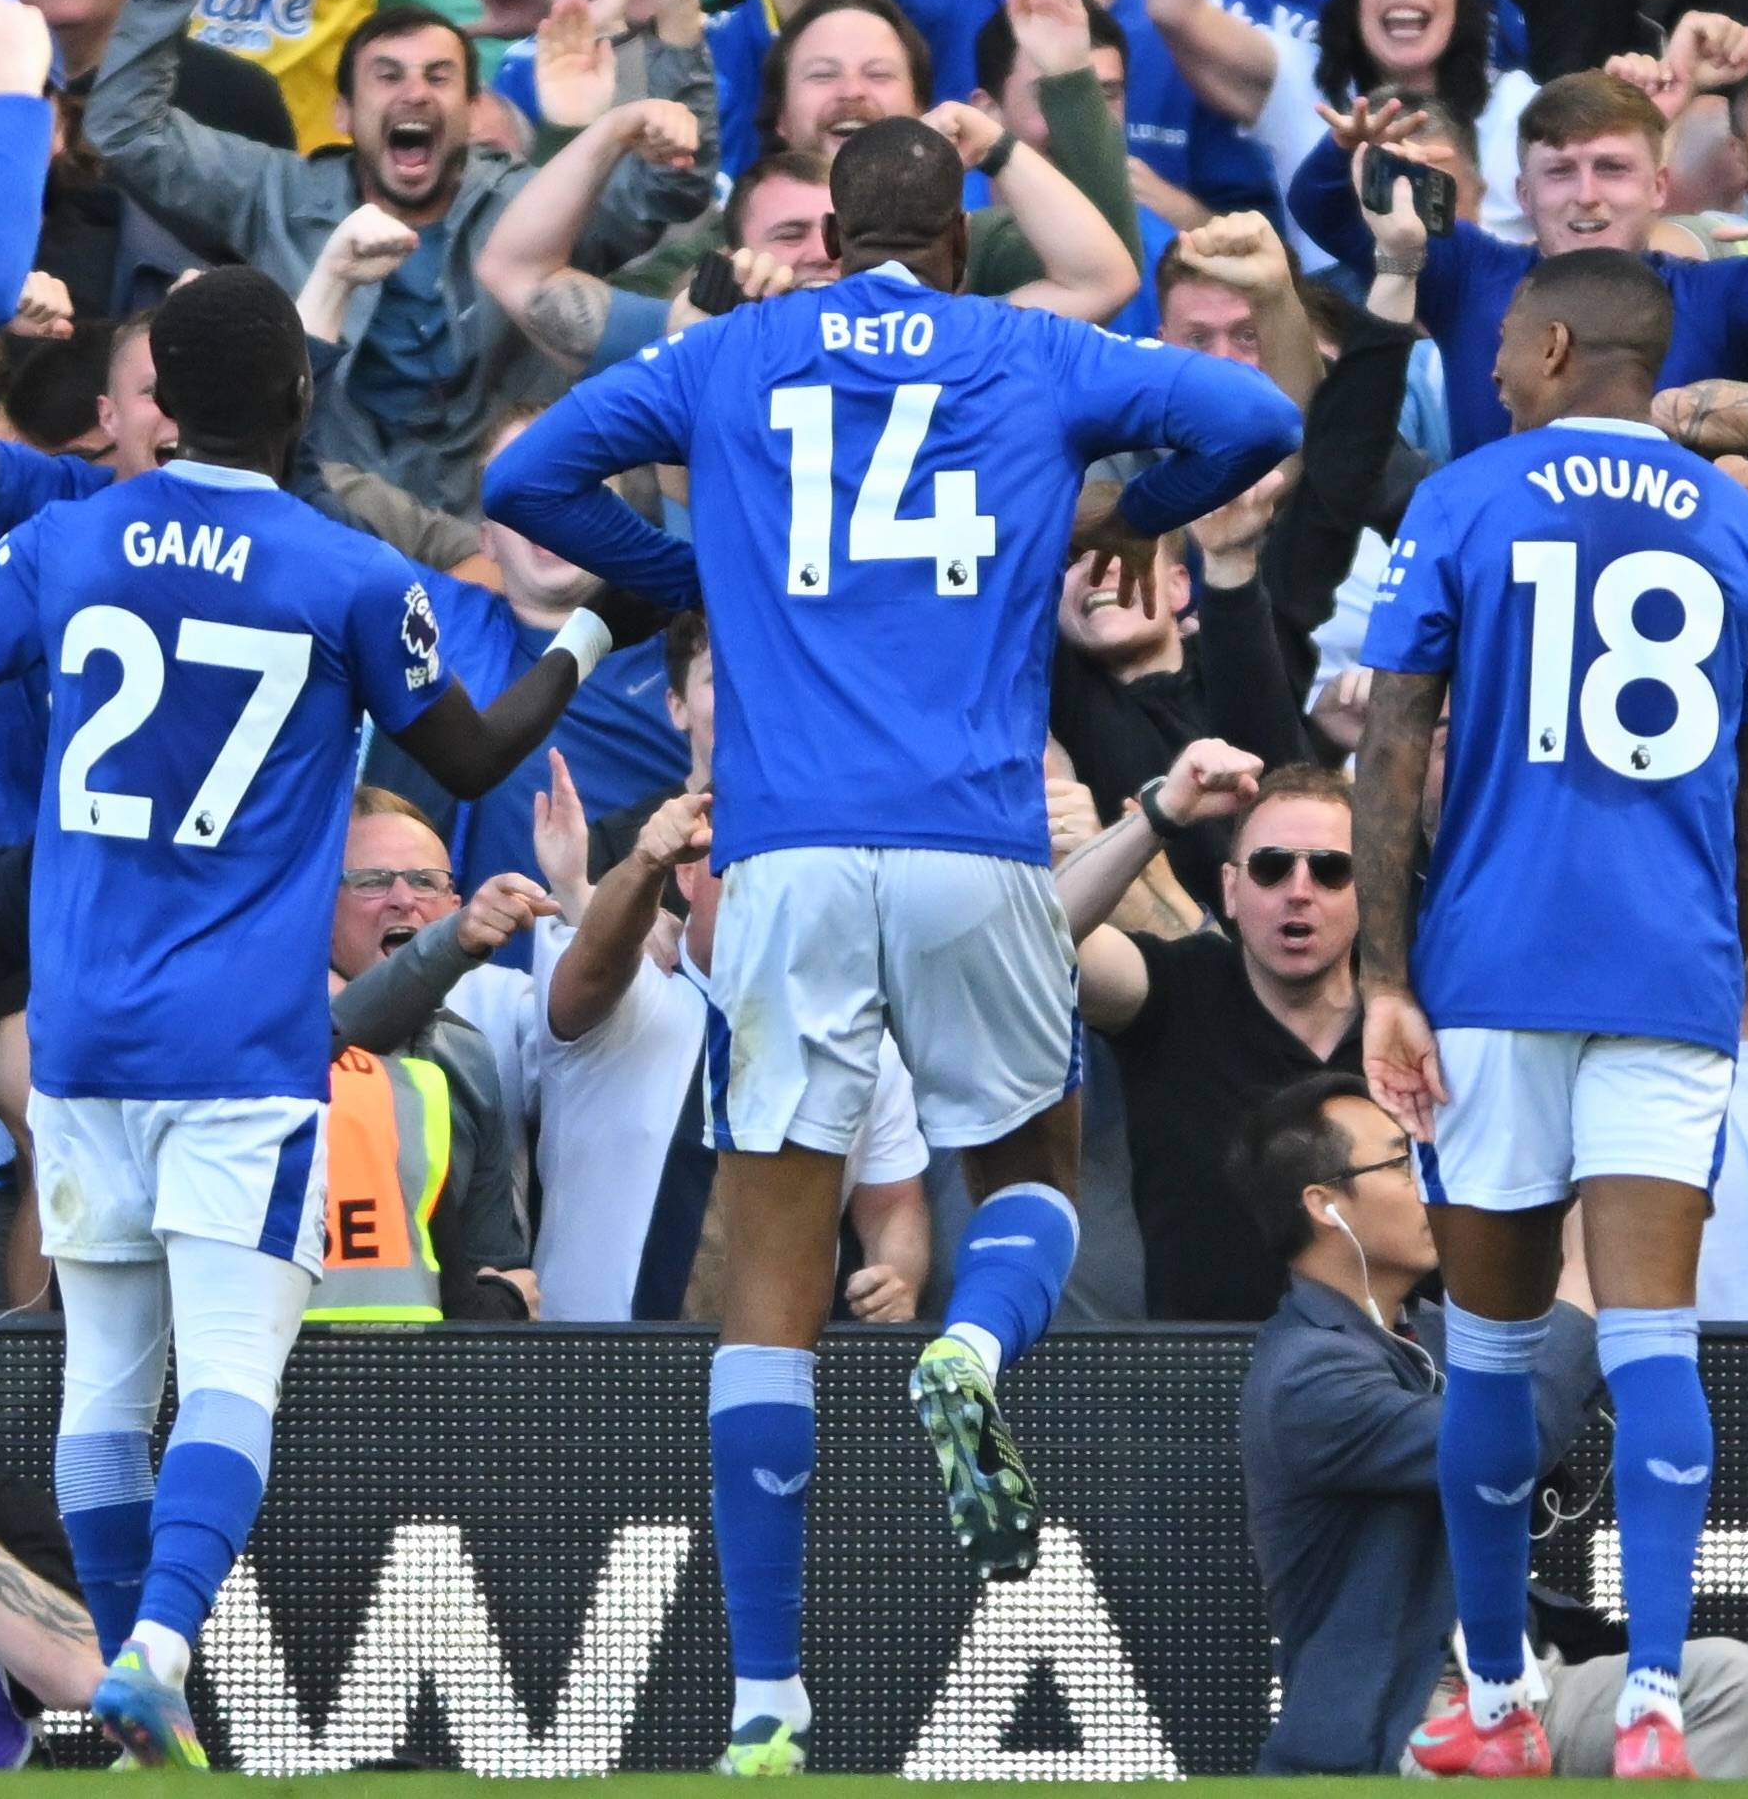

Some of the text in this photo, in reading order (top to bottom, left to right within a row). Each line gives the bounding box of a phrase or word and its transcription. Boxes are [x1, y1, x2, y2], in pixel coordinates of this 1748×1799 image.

[822, 311, 934, 357] BETO
[123, 521, 252, 583] GANA
[770, 383, 995, 596] 14
[1527, 455, 1700, 520] YOUNG
[59, 605, 313, 847] 27
[1512, 540, 1725, 781] 18
